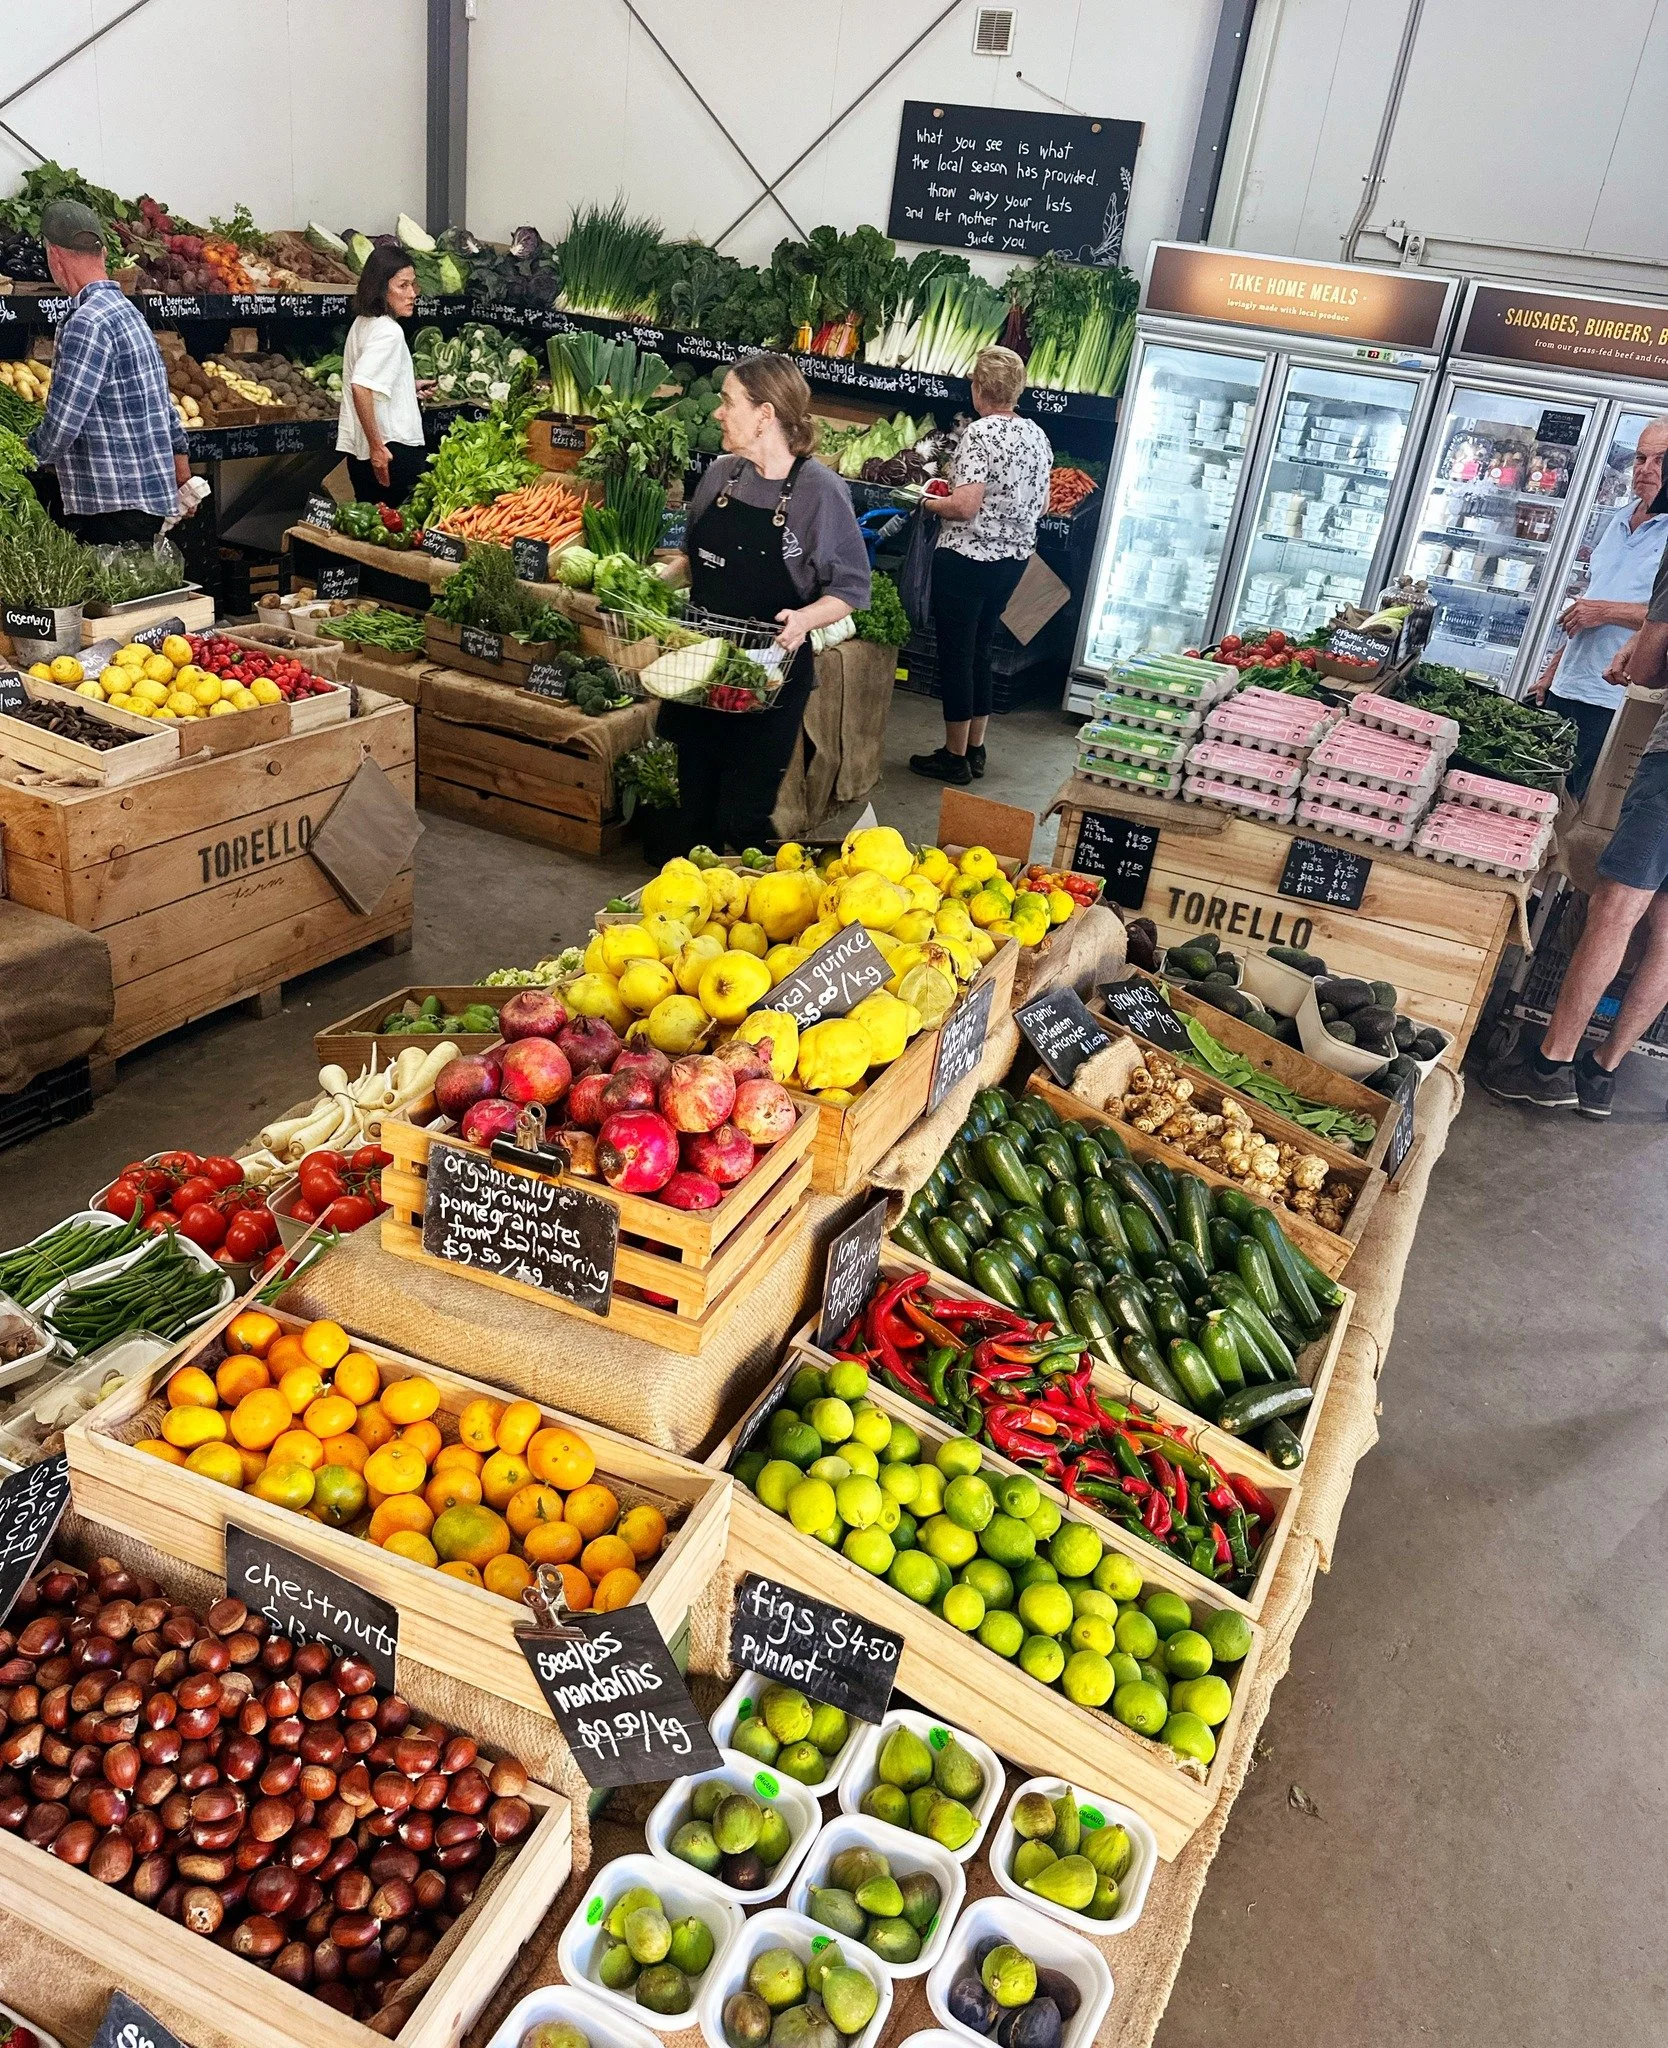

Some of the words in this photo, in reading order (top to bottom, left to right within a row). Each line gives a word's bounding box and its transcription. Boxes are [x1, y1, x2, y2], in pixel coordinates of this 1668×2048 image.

[952, 136, 976, 152] you
[986, 139, 1002, 152] see
[1018, 141, 1029, 155] is
[912, 154, 930, 170] the
[938, 154, 963, 173] local
[971, 160, 1008, 175] season
[1017, 162, 1038, 179] has
[1042, 168, 1099, 190] provided.
[928, 182, 956, 198] throw
[969, 189, 999, 210] away
[1004, 195, 1032, 211] your
[1046, 195, 1072, 213] lists
[905, 206, 923, 219] and
[935, 206, 952, 221] let
[958, 210, 997, 227] mother
[1009, 214, 1050, 233] nature
[965, 232, 994, 247] guide
[149, 296, 163, 307] red
[1229, 273, 1264, 293] TAKE
[1266, 277, 1307, 300] HOME
[1310, 284, 1359, 306] MEALS
[1227, 298, 1257, 311] lovingly
[1258, 304, 1278, 313] made
[1279, 306, 1297, 315] with
[1299, 308, 1317, 318] local
[1318, 311, 1350, 322] produce
[1505, 308, 1580, 336] SAUSAGES,
[1584, 318, 1654, 347] BURGERS,
[1658, 328, 1668, 346] B
[1534, 339, 1554, 349] from
[1557, 343, 1572, 351] our
[1573, 345, 1612, 357] grass-fed
[1615, 350, 1634, 359] beef
[1635, 354, 1652, 362] and
[1036, 400, 1063, 412] $2.50
[1040, 519, 1070, 538] arrots
[6, 611, 51, 636] rosemary
[1330, 635, 1368, 656] tomatoes
[1336, 628, 1364, 643] organic
[1366, 638, 1390, 657] cherry
[198, 814, 312, 883] TORELLO
[1296, 882, 1313, 894] $15
[1168, 887, 1313, 950] TORELLO
[765, 979, 812, 1013] ocal
[812, 931, 872, 988] quince
[1023, 1003, 1057, 1032] organic
[1034, 1016, 1075, 1049] jerusalem
[1047, 1025, 1087, 1060] artichoke
[480, 1186, 538, 1217] grown
[440, 1193, 580, 1249] pomegranates
[448, 1217, 492, 1244] from
[500, 1230, 609, 1293] balnarring
[836, 1235, 860, 1272] long
[245, 1563, 397, 1656] chestnuts
[749, 1581, 815, 1645] figs
[537, 1631, 623, 1681] seedless
[553, 1662, 663, 1714] mandarins
[757, 1774, 777, 1795] ORGANIC
